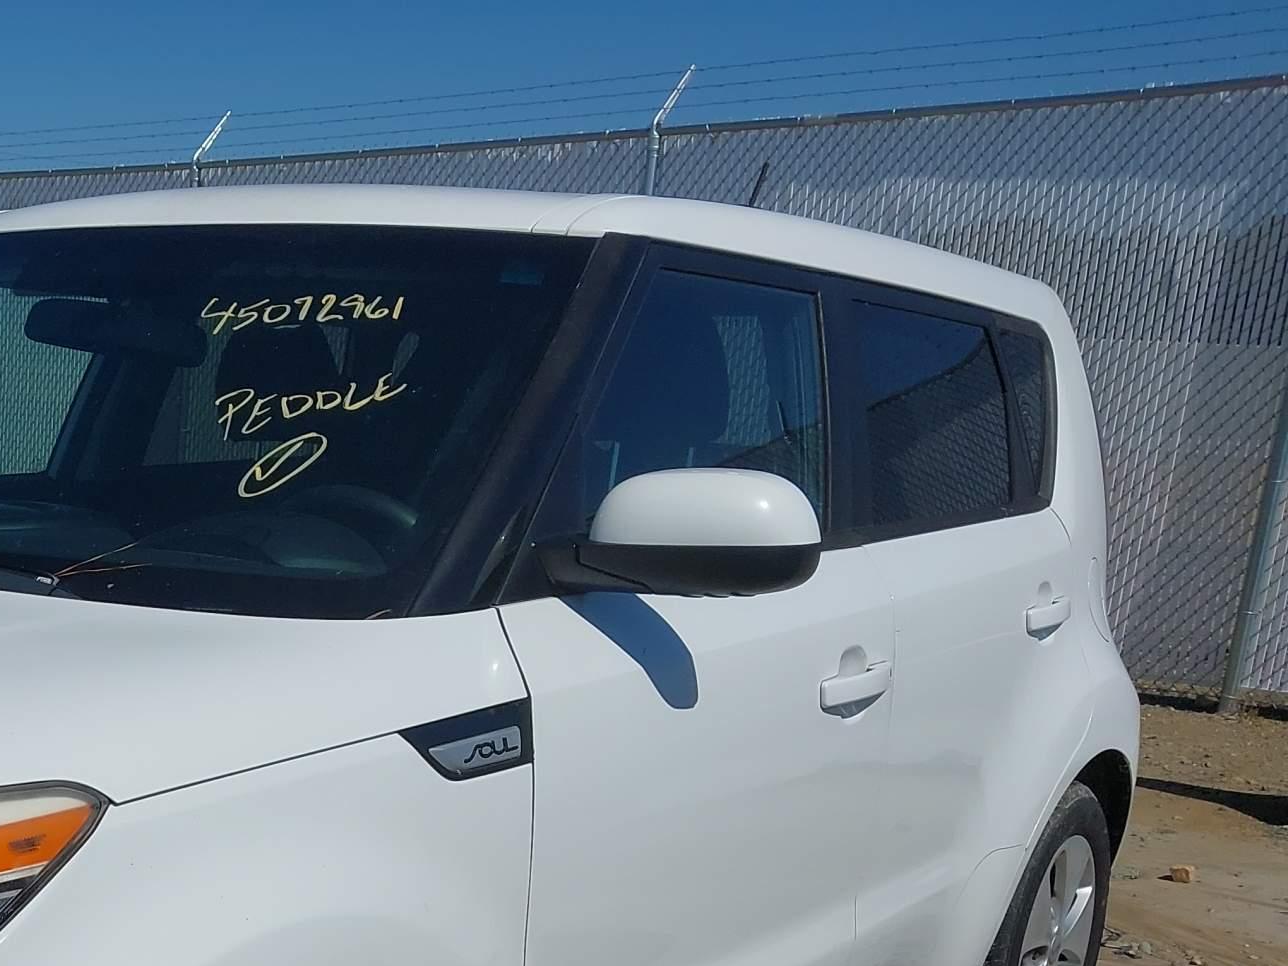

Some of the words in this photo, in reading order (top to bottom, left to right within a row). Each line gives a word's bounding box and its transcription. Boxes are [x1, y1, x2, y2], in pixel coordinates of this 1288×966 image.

[201, 294, 404, 335] 45072961
[215, 373, 407, 440] PEDDLE
[464, 737, 518, 763] SOUL
